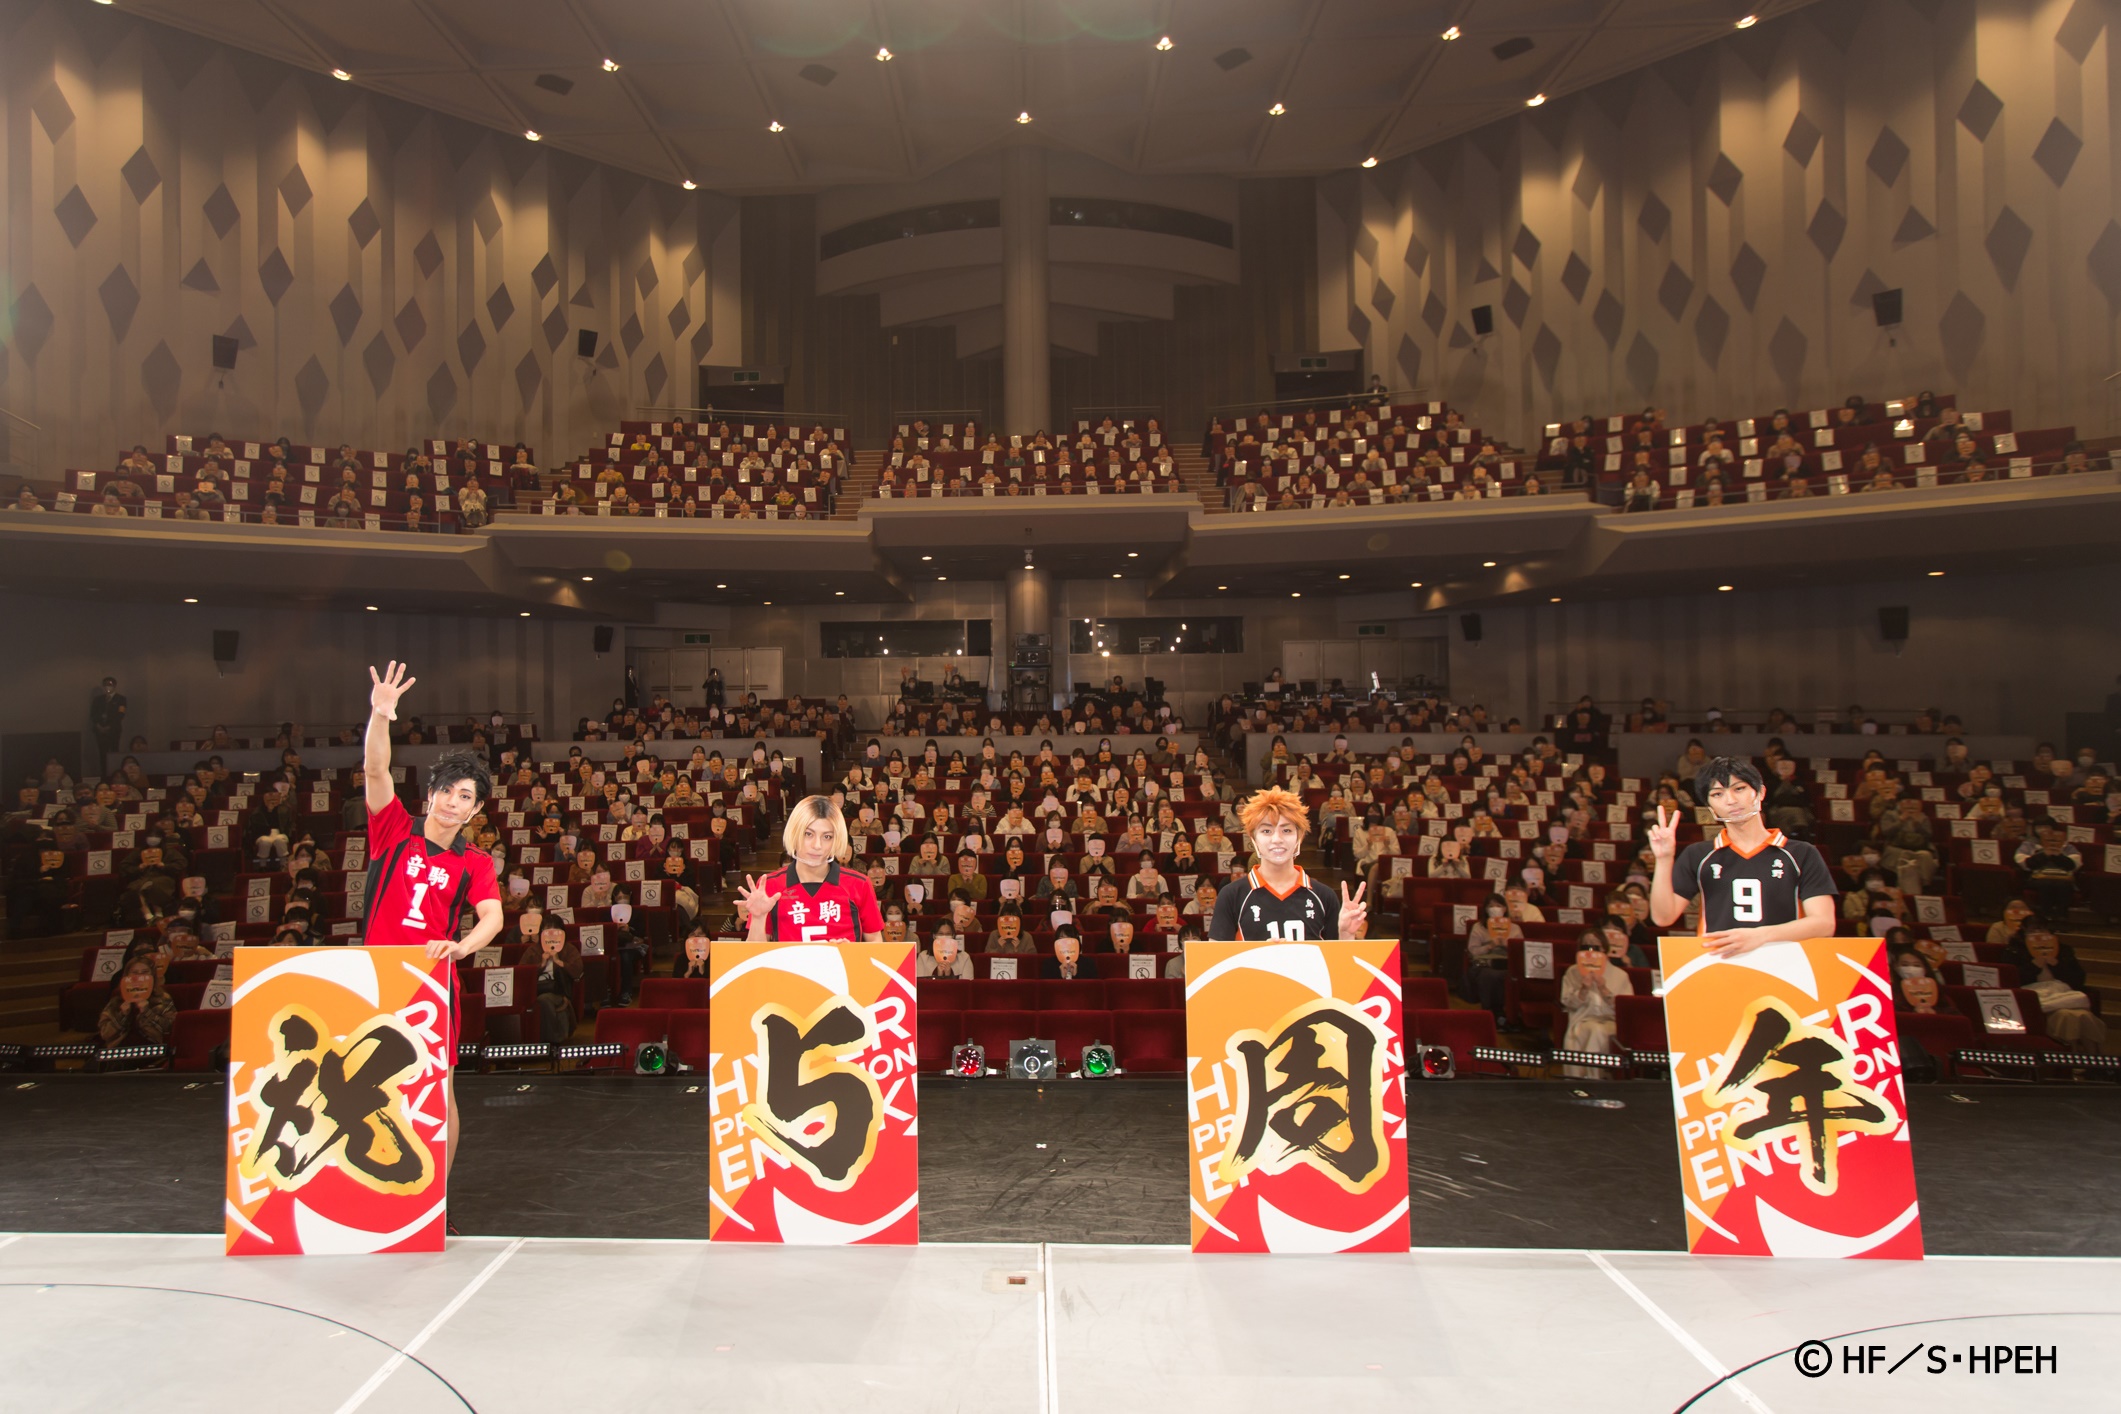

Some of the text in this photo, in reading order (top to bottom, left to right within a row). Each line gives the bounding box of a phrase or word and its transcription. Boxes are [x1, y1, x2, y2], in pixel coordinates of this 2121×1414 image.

[405, 854, 450, 891] 音駒
[403, 882, 429, 930] 1
[787, 899, 842, 925] 音駒
[1732, 878, 1763, 922] 9
[749, 1001, 878, 1186] 5
[1225, 1003, 1384, 1187] 周
[1709, 1001, 1892, 1189] 年
